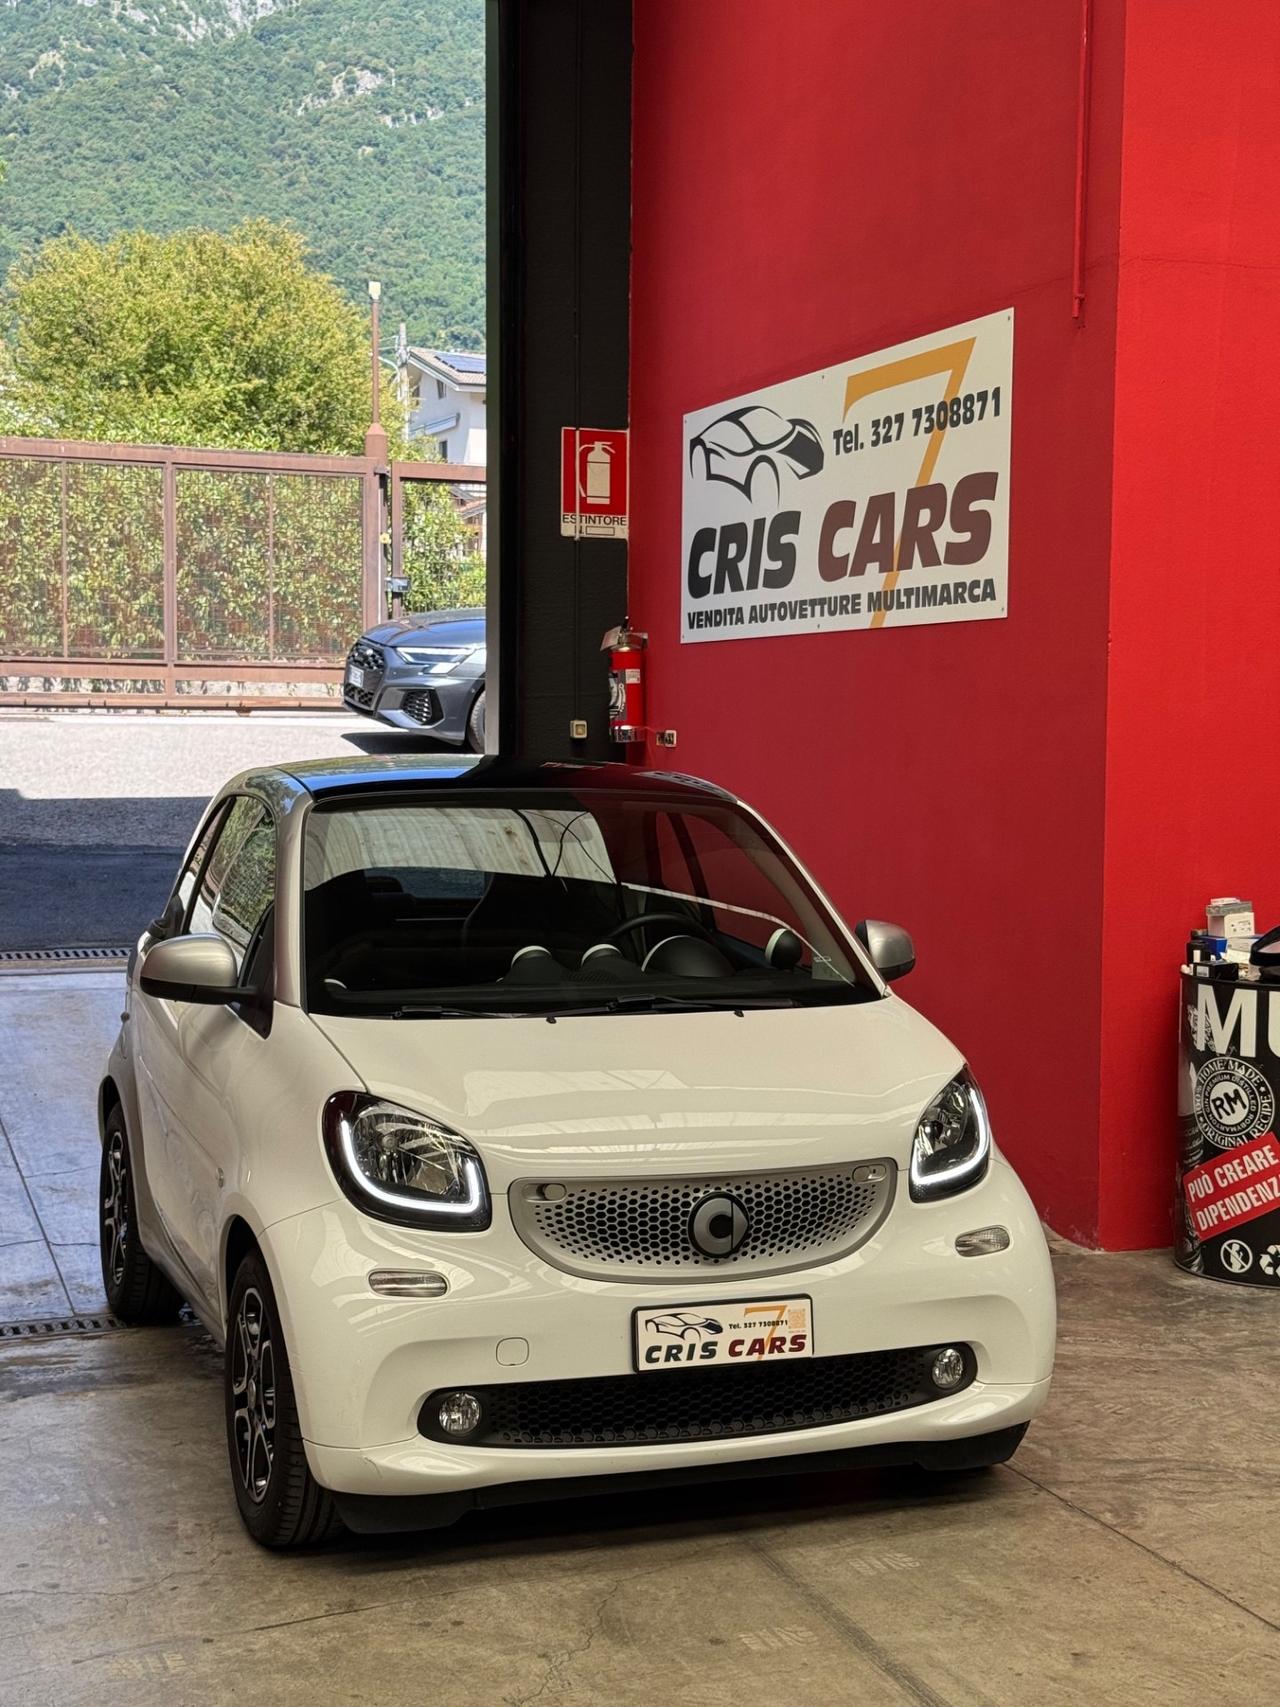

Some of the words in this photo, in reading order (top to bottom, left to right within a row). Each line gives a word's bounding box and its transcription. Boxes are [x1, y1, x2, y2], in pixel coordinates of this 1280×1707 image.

[833, 423, 864, 456] Tel.
[871, 412, 904, 447] 327
[912, 386, 1000, 437] 7308871
[562, 513, 627, 526] ESTINTORE
[688, 510, 801, 599] CRIS
[818, 472, 999, 582] CARS
[688, 607, 745, 630] VENDITA
[749, 592, 861, 624] AUTOVETTURE
[867, 578, 996, 612] MULTIMARCA
[1198, 983, 1280, 1058] M
[1199, 1059, 1225, 1084] HOME
[1227, 1060, 1263, 1087] MADE
[1205, 1074, 1231, 1097] PREMIUM
[1231, 1075, 1257, 1111] DISTILLED
[1211, 1088, 1247, 1120] RM
[1249, 1094, 1273, 1139] RECIPE
[1188, 1170, 1214, 1203] PUÒ
[1214, 1145, 1279, 1188] CREARE
[1196, 1174, 1280, 1231] DIPENDENZ
[645, 1341, 718, 1364] CRIS
[728, 1334, 807, 1358] CARS
